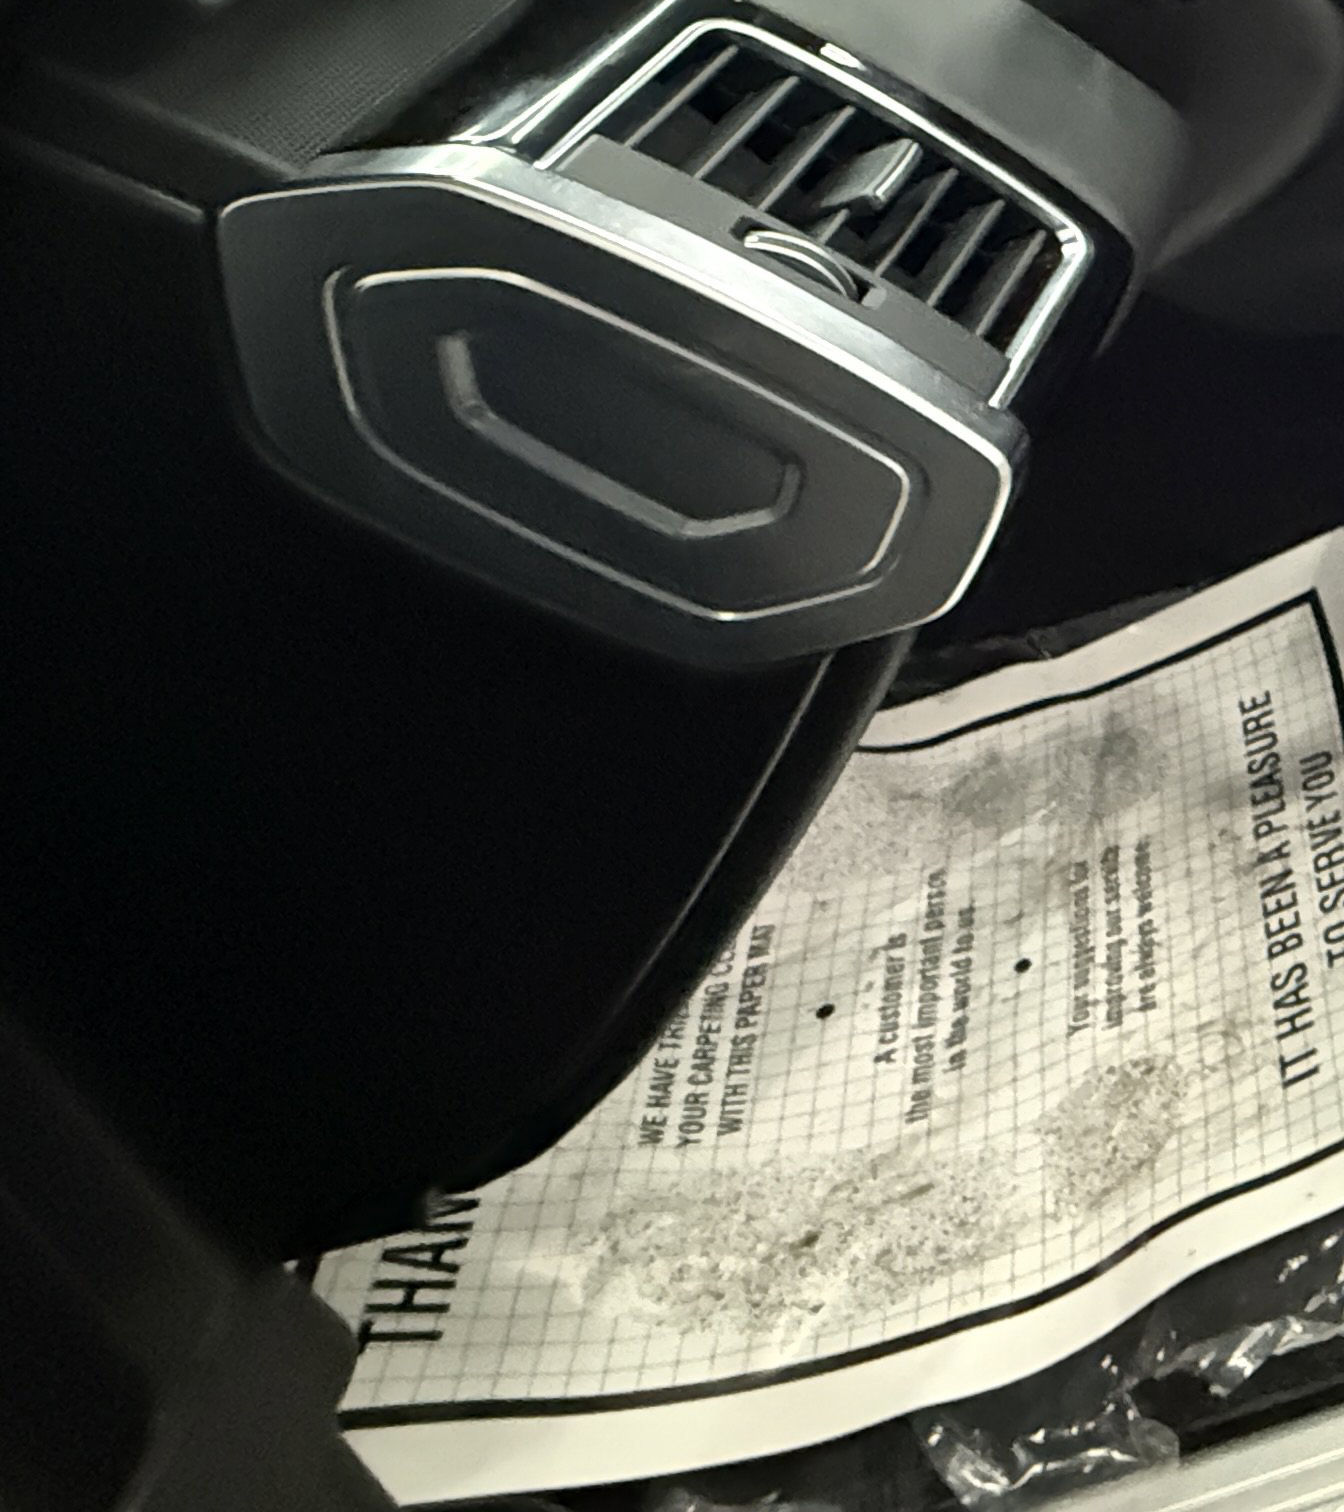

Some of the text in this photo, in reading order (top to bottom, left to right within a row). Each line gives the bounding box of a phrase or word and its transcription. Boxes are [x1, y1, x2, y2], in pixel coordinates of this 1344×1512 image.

[1299, 750, 1338, 809] YOU
[1239, 690, 1320, 1088] IT HAS BEEN A PLEASURE
[951, 933, 975, 954] to
[877, 956, 905, 1045] customer
[912, 935, 944, 1030] important
[950, 957, 973, 1012] world
[687, 982, 729, 1087] CARPETING
[717, 924, 776, 1137] WITH THIS PAPER MAT
[873, 1048, 897, 1064] A
[945, 1015, 969, 1049] the
[646, 1057, 679, 1109] HAVE
[912, 1034, 935, 1085] most
[638, 1114, 667, 1149] WE
[675, 1092, 709, 1149] YOUR
[904, 1089, 932, 1124] the
